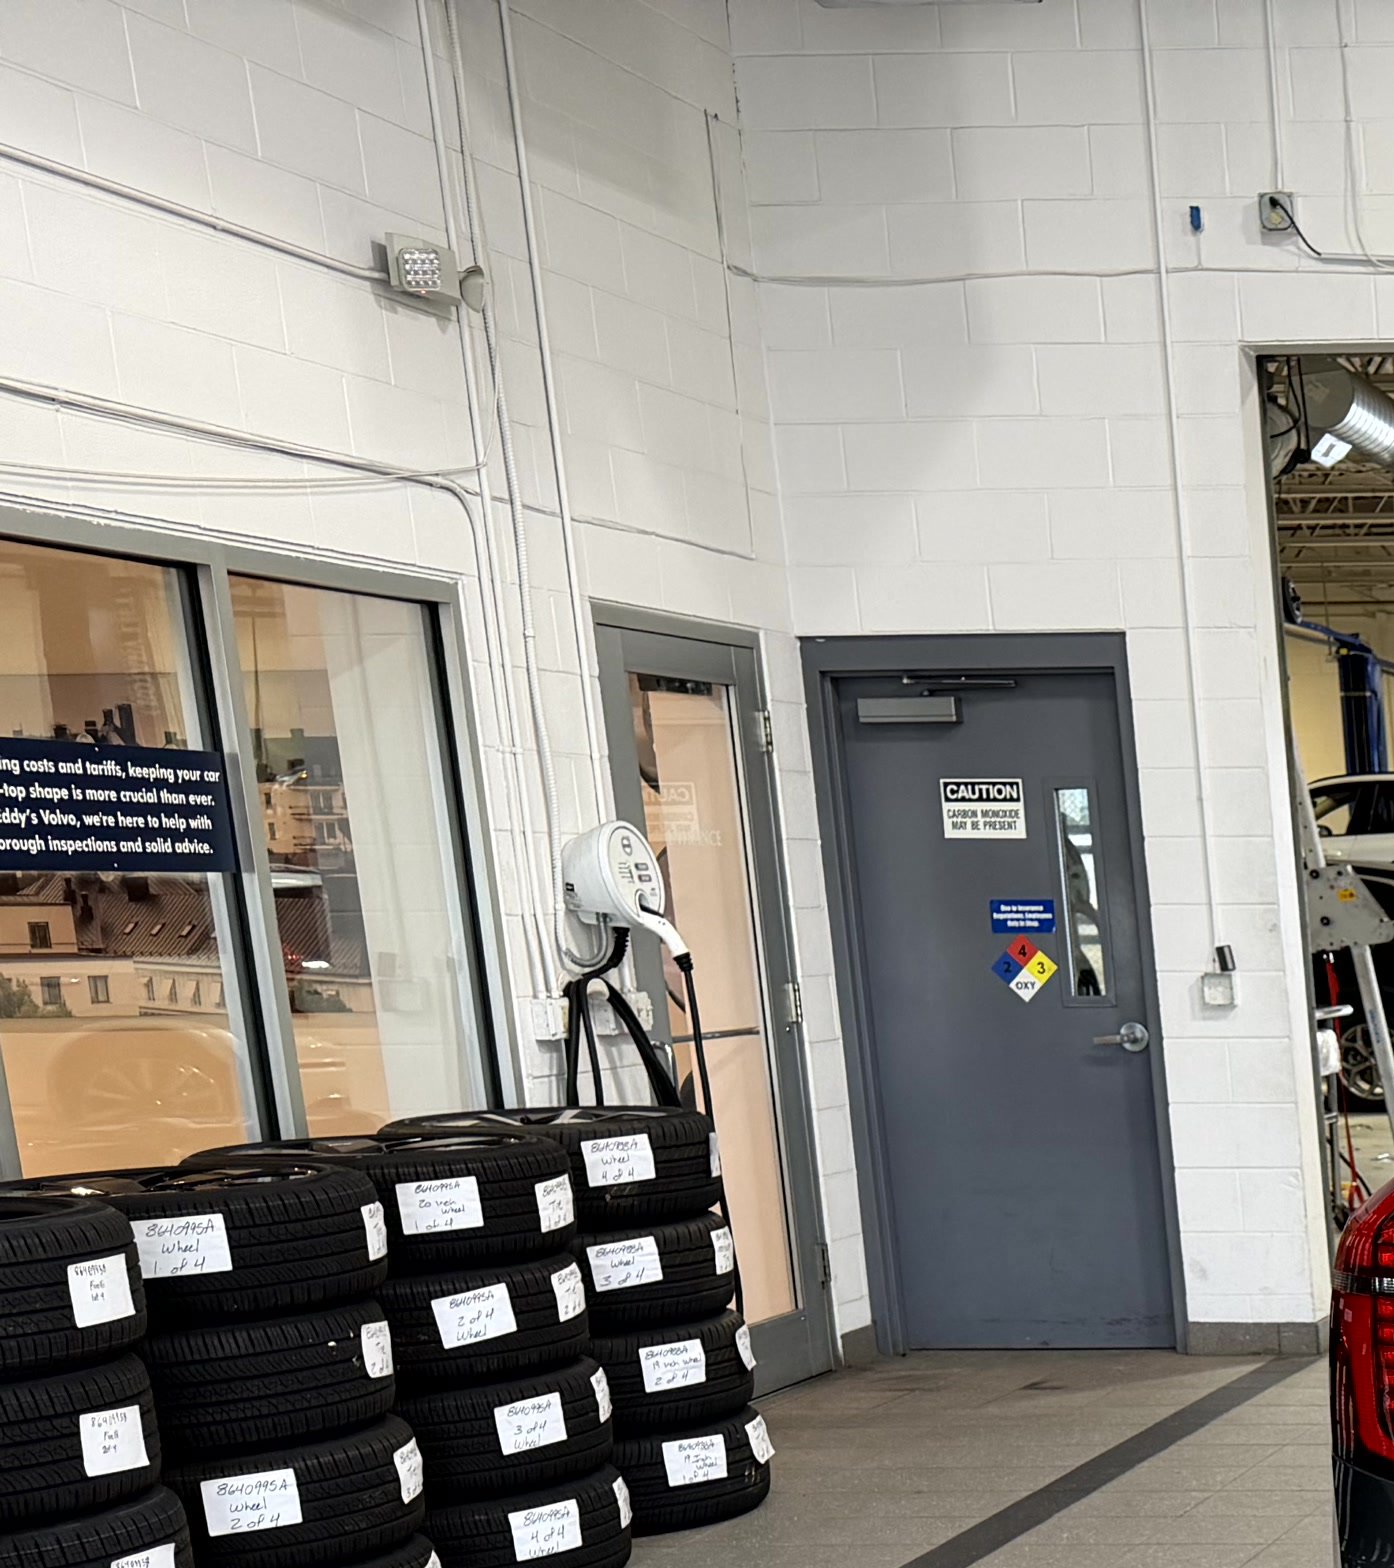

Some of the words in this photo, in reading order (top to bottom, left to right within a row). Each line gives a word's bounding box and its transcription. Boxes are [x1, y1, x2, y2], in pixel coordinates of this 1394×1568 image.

[23, 758, 55, 774] costs
[58, 758, 83, 775] and
[86, 760, 126, 779] tariffs,
[127, 761, 175, 784] keeping
[176, 769, 201, 784] your
[203, 769, 221, 782] car
[29, 782, 69, 803] shape
[71, 784, 83, 800] is
[85, 789, 117, 802] more
[120, 788, 158, 804] crucial
[160, 788, 186, 805] than
[188, 793, 215, 806] ever.
[946, 784, 1018, 799] CAUTION
[40, 809, 81, 828] Volvo,
[83, 812, 115, 827] we're
[118, 811, 145, 828] here
[147, 814, 159, 828] to
[162, 813, 186, 832] help
[189, 814, 212, 830] with
[947, 809, 978, 819] CARBON
[981, 809, 1020, 819] MONOXIDE
[952, 820, 967, 830] MAY
[971, 820, 981, 830] BE
[983, 820, 1017, 830] PRESENT
[48, 836, 117, 855] inspections
[119, 837, 142, 853] and
[145, 837, 172, 853] solid
[175, 838, 214, 854] advice.
[1018, 944, 1027, 957] 4
[1003, 961, 1012, 973] 2
[1037, 961, 1046, 974] 3
[1015, 981, 1036, 990] OXY
[628, 1166, 634, 1180] 4
[445, 1217, 453, 1228] 4
[154, 1260, 158, 1275] 1
[170, 1258, 188, 1274] of
[194, 1256, 206, 1271] 4
[457, 1316, 465, 1327] 2
[469, 1310, 482, 1324] of
[486, 1307, 494, 1320] 4
[514, 1425, 522, 1435] 3
[539, 1420, 547, 1432] 4
[216, 1478, 288, 1496] 8640995A
[230, 1518, 242, 1530] 2
[247, 1514, 265, 1529] of
[270, 1512, 280, 1527] 4
[531, 1530, 539, 1543] 4
[557, 1524, 565, 1539] 4
